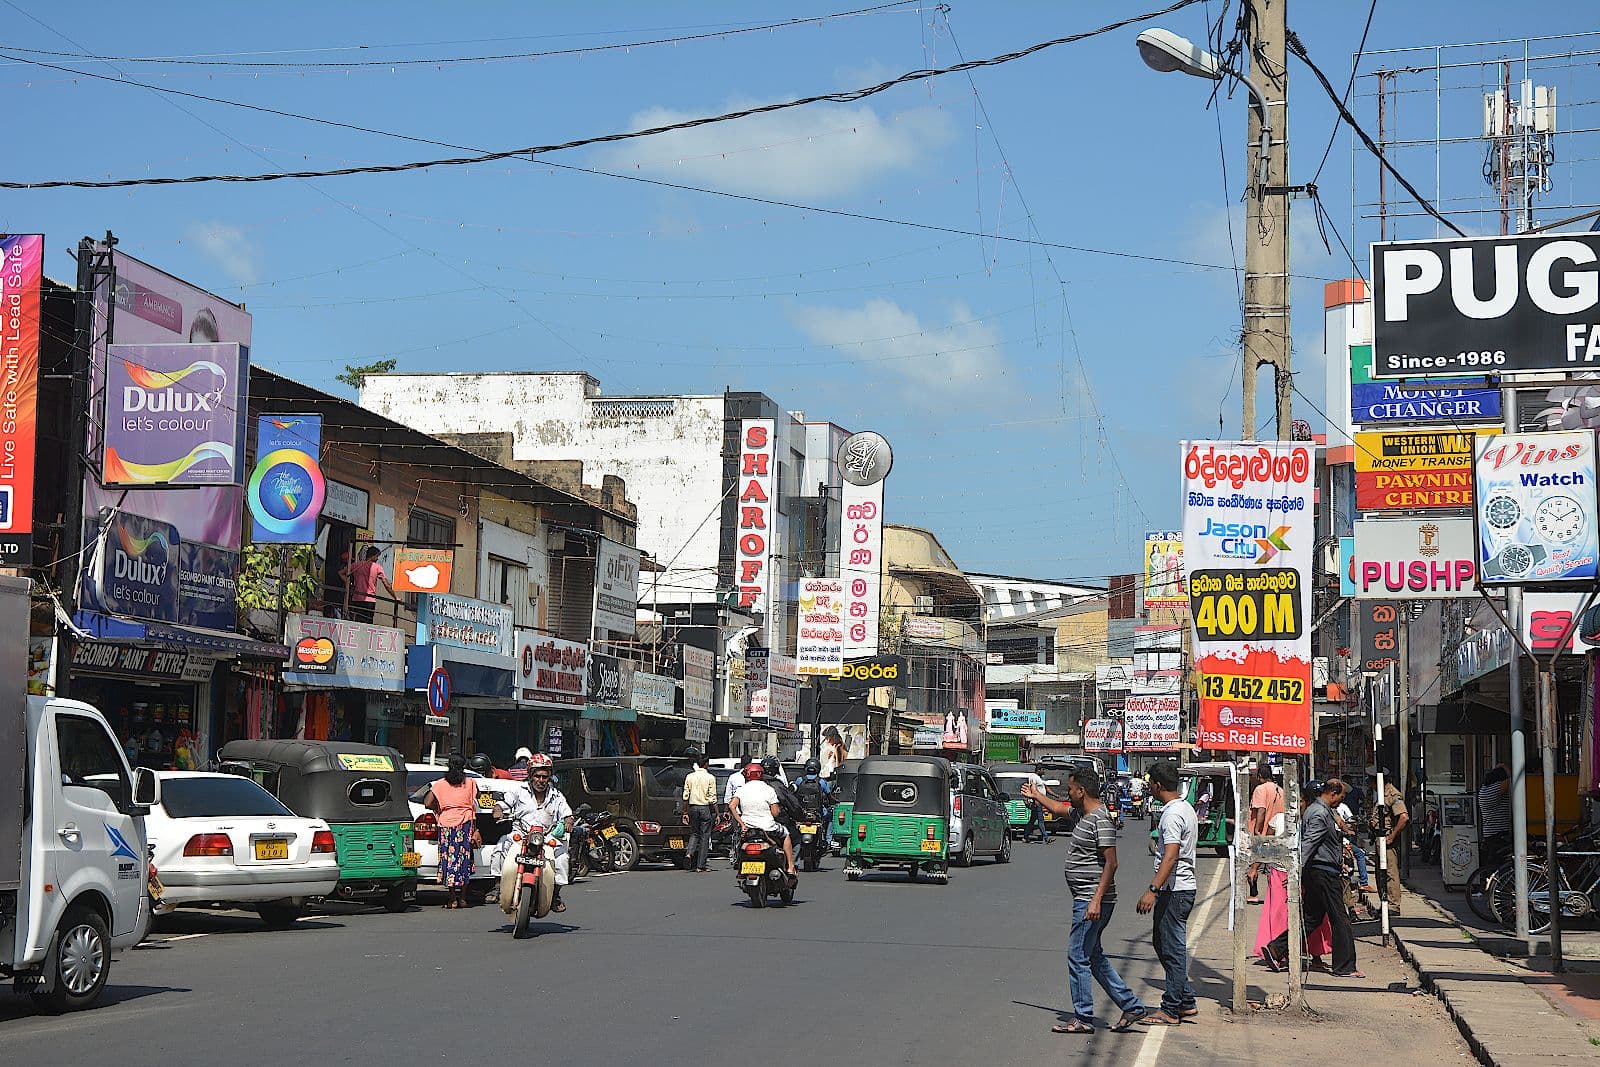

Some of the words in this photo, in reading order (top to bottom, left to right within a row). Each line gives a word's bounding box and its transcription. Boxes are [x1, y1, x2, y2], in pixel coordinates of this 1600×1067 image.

[8, 243, 23, 286] Safe
[8, 298, 21, 341] Lead
[5, 350, 19, 389] with
[1387, 350, 1506, 370] Since-1986
[123, 386, 212, 413] Dulux
[1369, 401, 1482, 418] CHANGER
[3, 391, 17, 435] Safe
[122, 416, 154, 431] let's
[159, 417, 212, 431] colour
[1384, 436, 1436, 447] WESTERN
[1401, 446, 1436, 455] UNION
[1, 441, 15, 479] Live
[1372, 457, 1416, 468] MONEY
[1484, 442, 1582, 472] Vins
[1376, 472, 1474, 490] PAWNIN
[1520, 471, 1584, 488] Watch
[1385, 490, 1474, 506] CENTRE
[739, 427, 768, 607] SHAROFF
[1199, 517, 1267, 539] Jason
[1221, 538, 1257, 559] City
[114, 550, 161, 586] Dulux
[181, 570, 201, 584] EGOMBO
[132, 590, 160, 606] colour
[1197, 594, 1258, 636] 400
[1263, 593, 1296, 634] M
[367, 627, 398, 654] TEX
[1229, 677, 1263, 700] 452
[1267, 679, 1302, 702] 452
[1227, 712, 1263, 726] Access
[1229, 729, 1259, 746] Real
[1262, 731, 1306, 749] Estate
